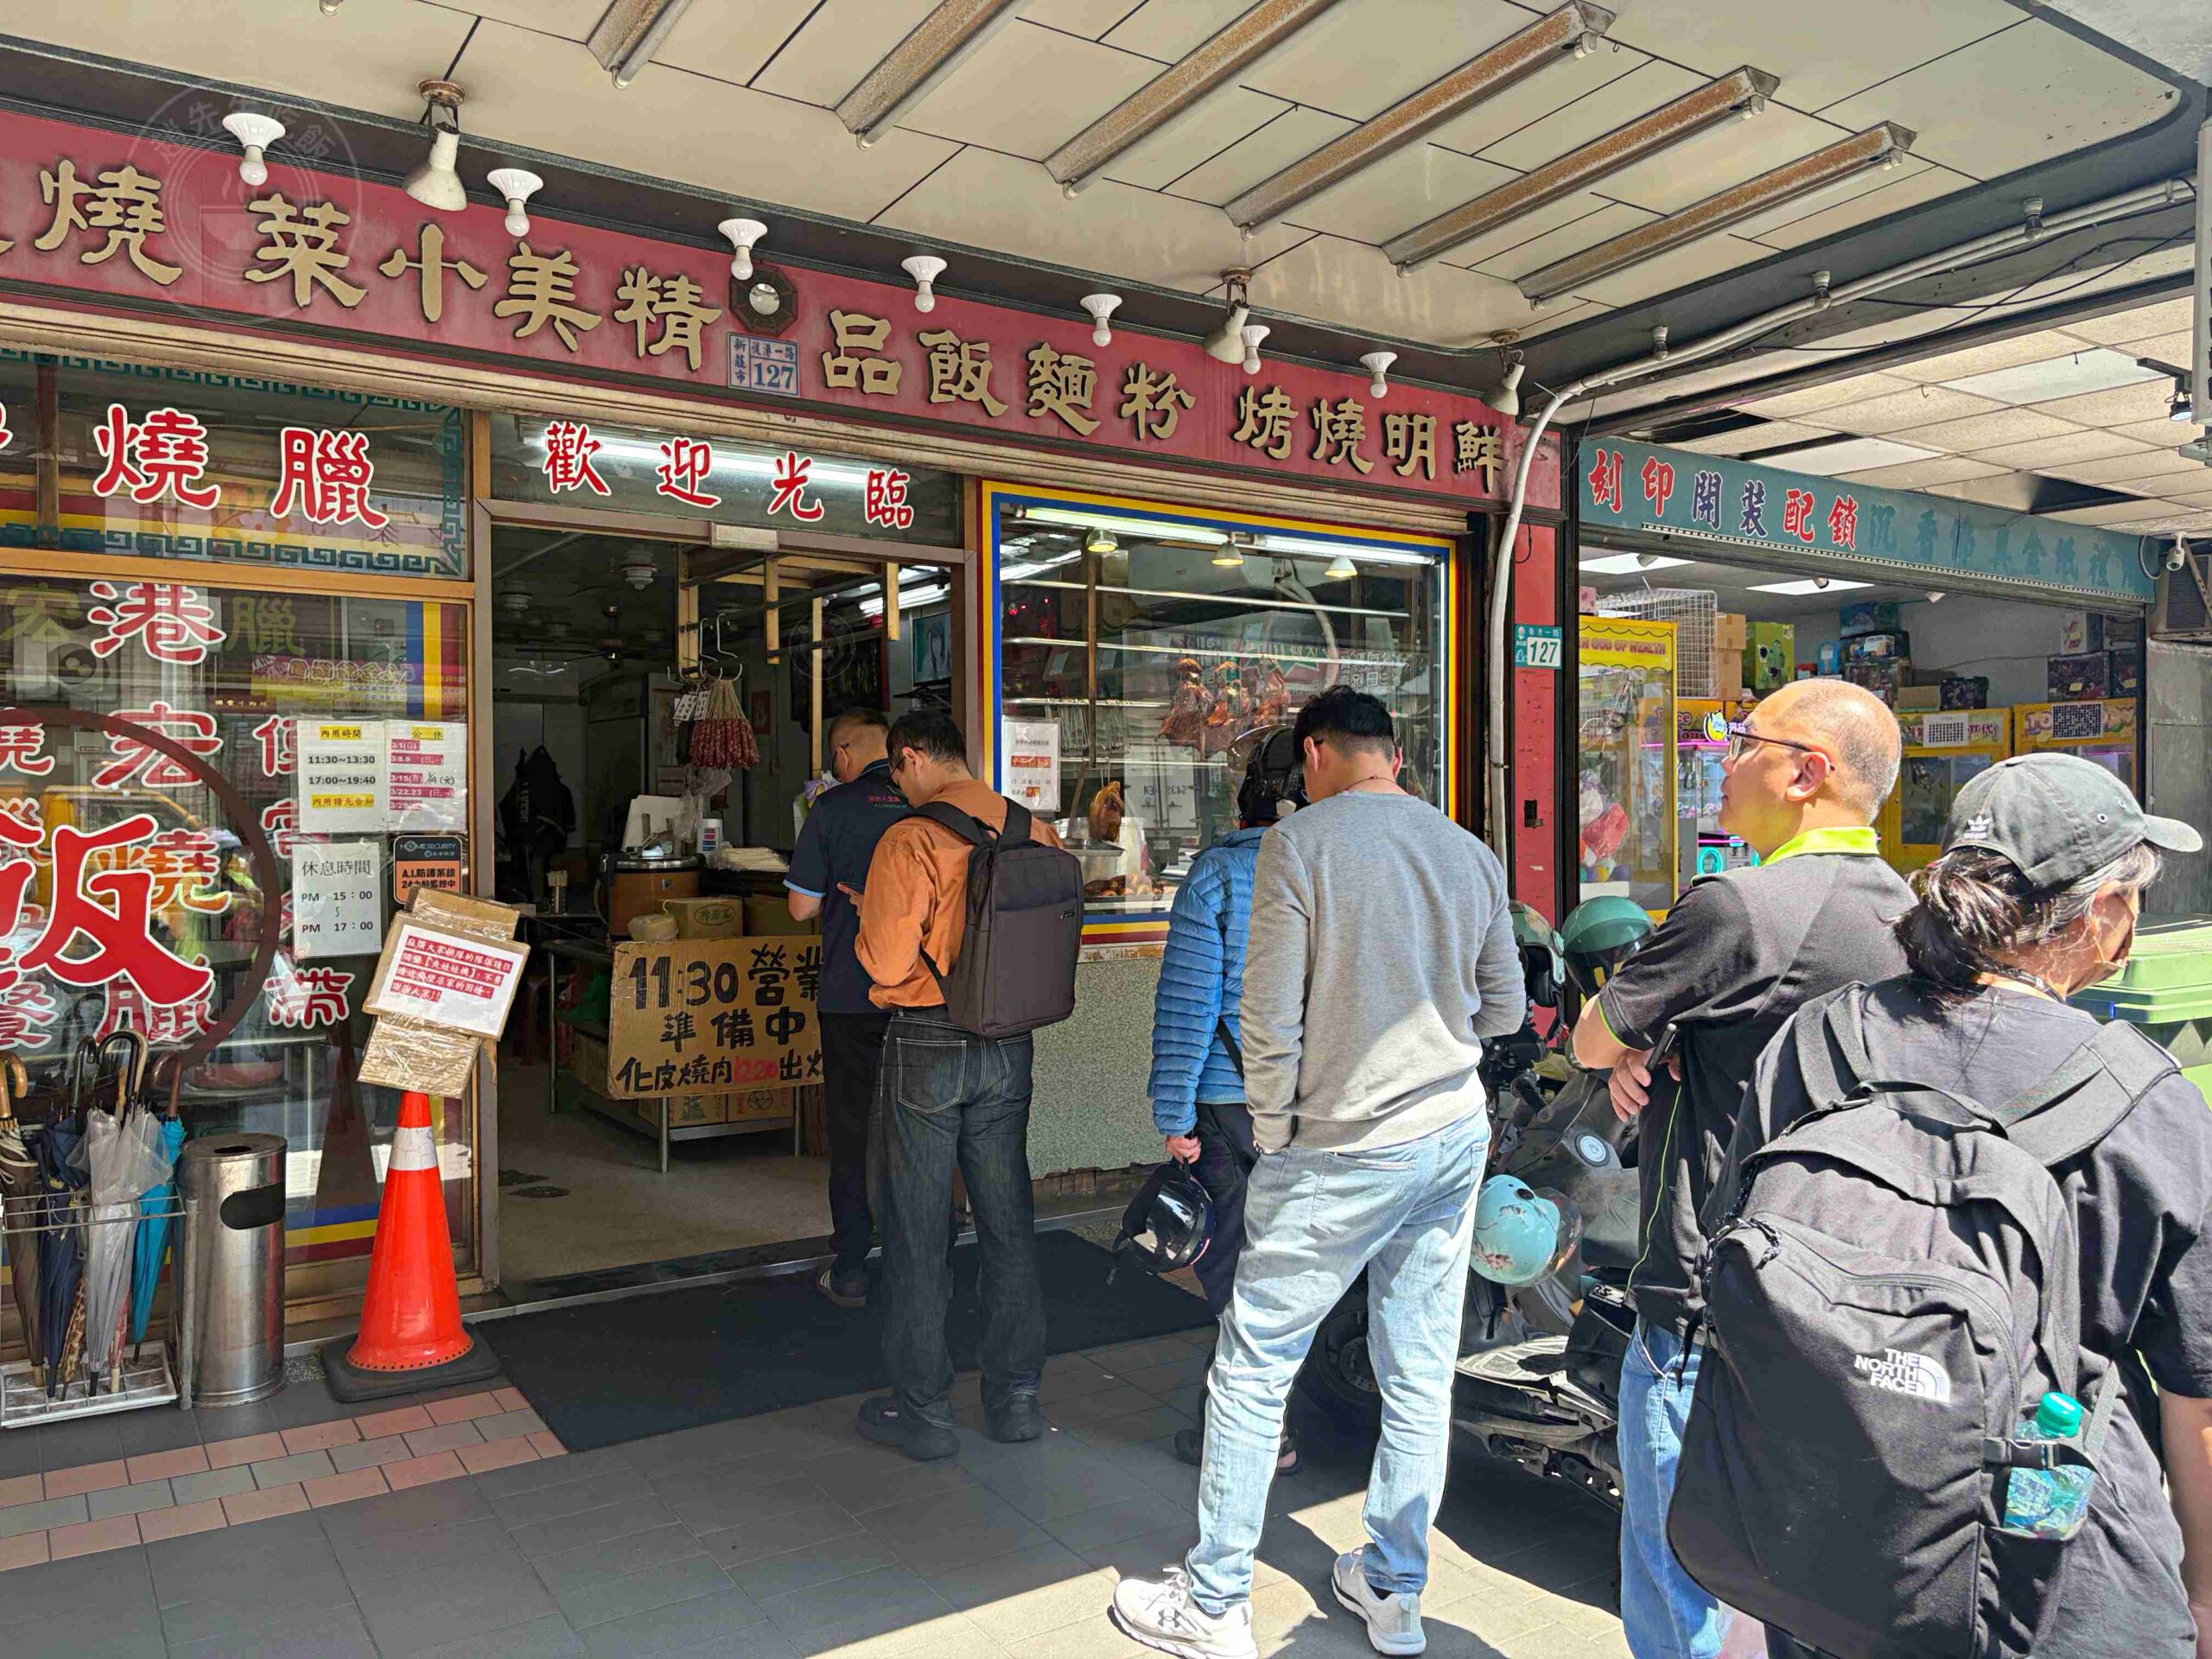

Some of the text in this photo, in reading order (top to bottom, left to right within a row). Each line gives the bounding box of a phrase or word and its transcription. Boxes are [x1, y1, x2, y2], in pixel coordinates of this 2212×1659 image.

[0, 159, 183, 287] 燒
[753, 362, 794, 389] 127
[0, 401, 391, 530] 燒臘
[543, 421, 915, 530] 歡迎光臨
[1529, 640, 1558, 664] 127
[308, 755, 376, 765] 11:30~13:30
[308, 776, 376, 785] 17:00~19:40
[302, 860, 372, 877] 休息時間
[302, 893, 320, 902] PM
[302, 924, 321, 933] PM
[660, 1007, 806, 1052] 準備中
[1854, 1354, 1918, 1382] NORTH
[1885, 1348, 1919, 1367] THE
[1871, 1372, 1917, 1395] FACE
